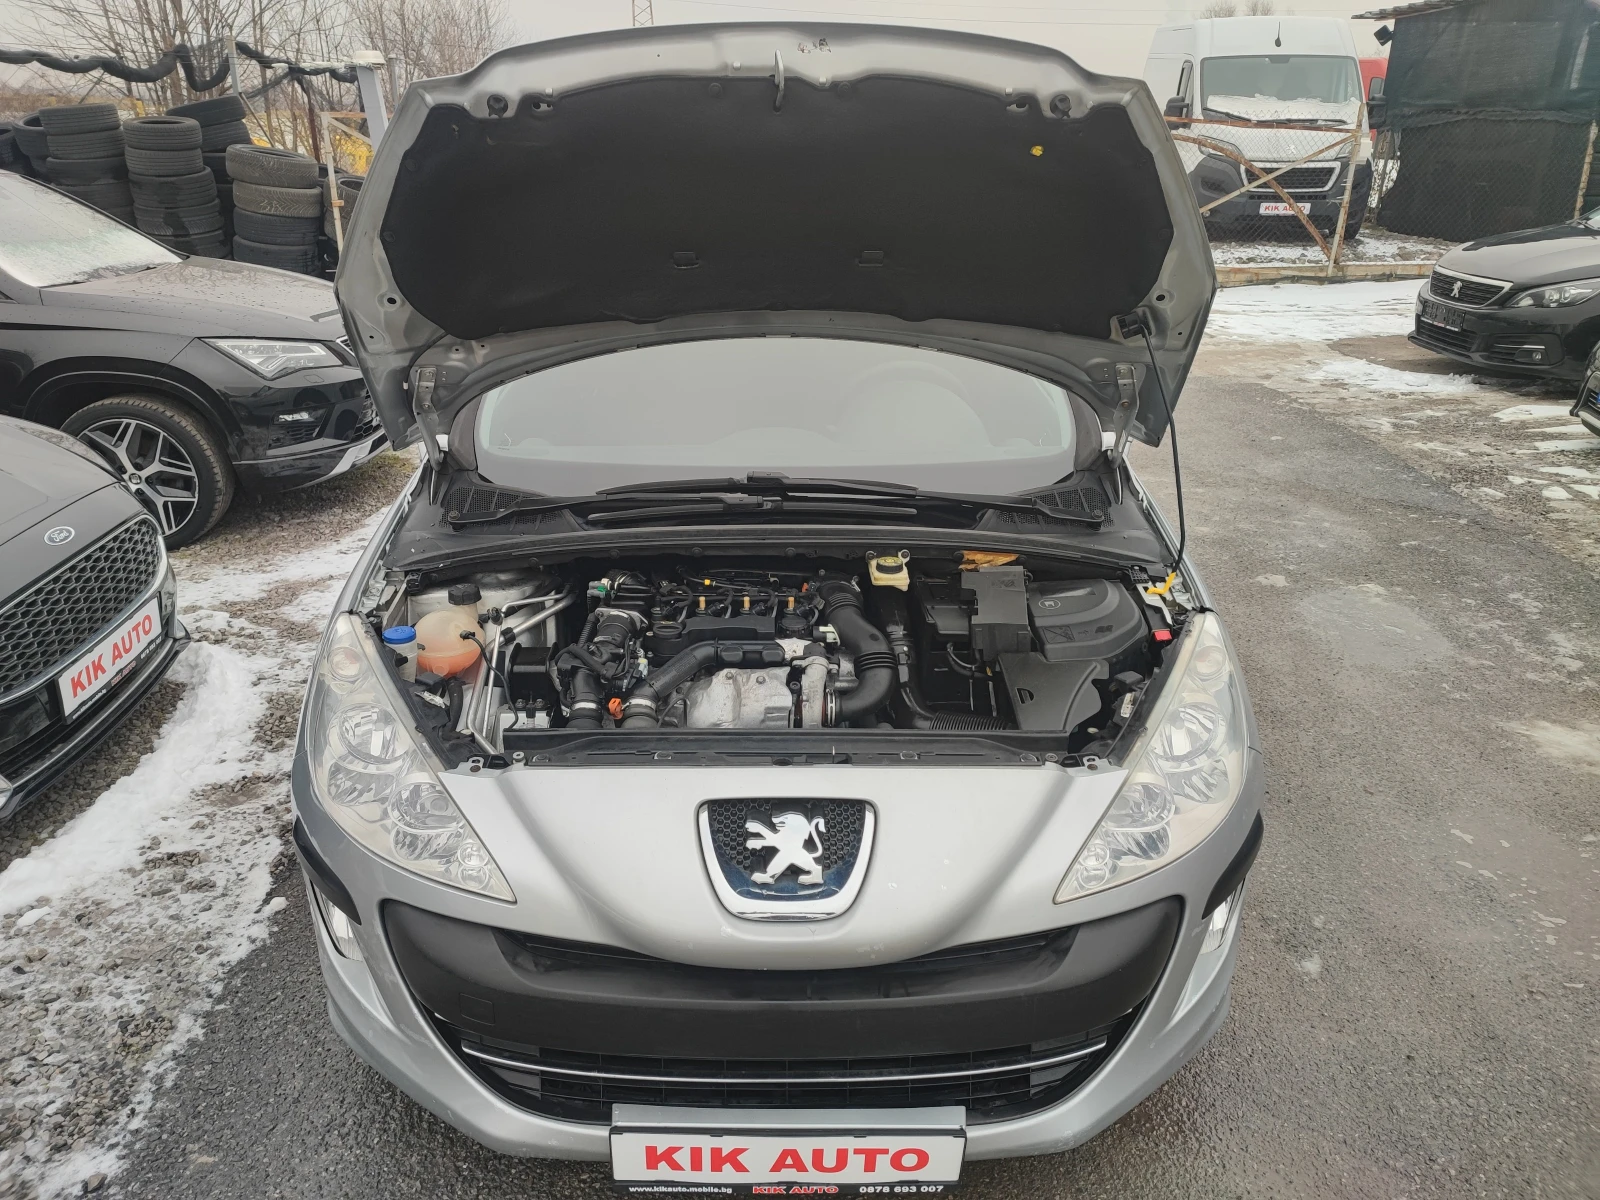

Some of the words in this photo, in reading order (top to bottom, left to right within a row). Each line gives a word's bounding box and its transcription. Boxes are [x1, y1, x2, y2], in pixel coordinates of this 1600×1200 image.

[70, 653, 107, 699] KIK
[111, 614, 153, 667] AUTO
[645, 1145, 751, 1173] KIK
[768, 1148, 930, 1174] AUTO
[628, 1186, 733, 1194] www.kikauto.mobile.bg
[752, 1186, 787, 1194] KIK
[789, 1186, 839, 1194] AUTO
[920, 1185, 944, 1193] 007
